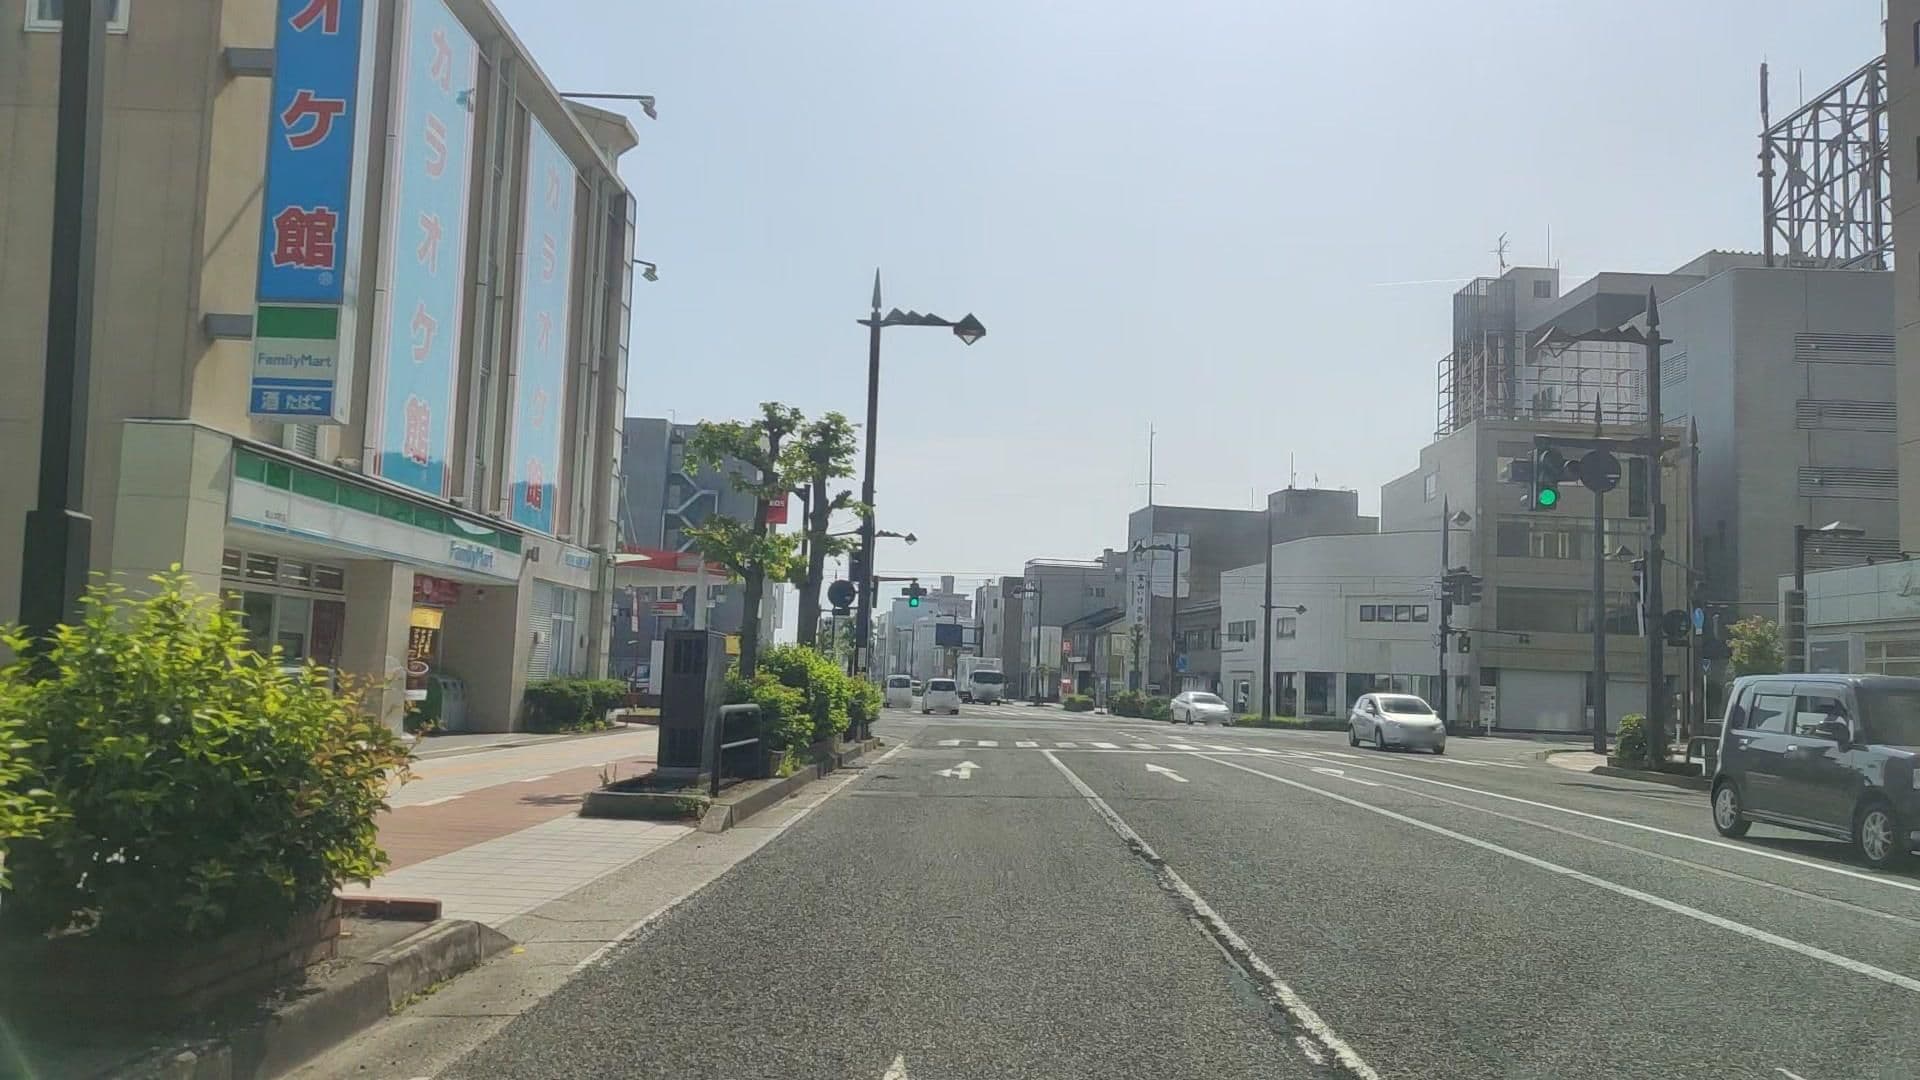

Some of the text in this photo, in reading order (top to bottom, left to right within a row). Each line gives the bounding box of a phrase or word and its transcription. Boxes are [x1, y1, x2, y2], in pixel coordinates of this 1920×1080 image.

[403, 29, 453, 465] カラオケ館
[257, 352, 332, 369] FamilyMart
[262, 391, 323, 411] 酒 たばこ
[527, 167, 561, 510] カラオケ館
